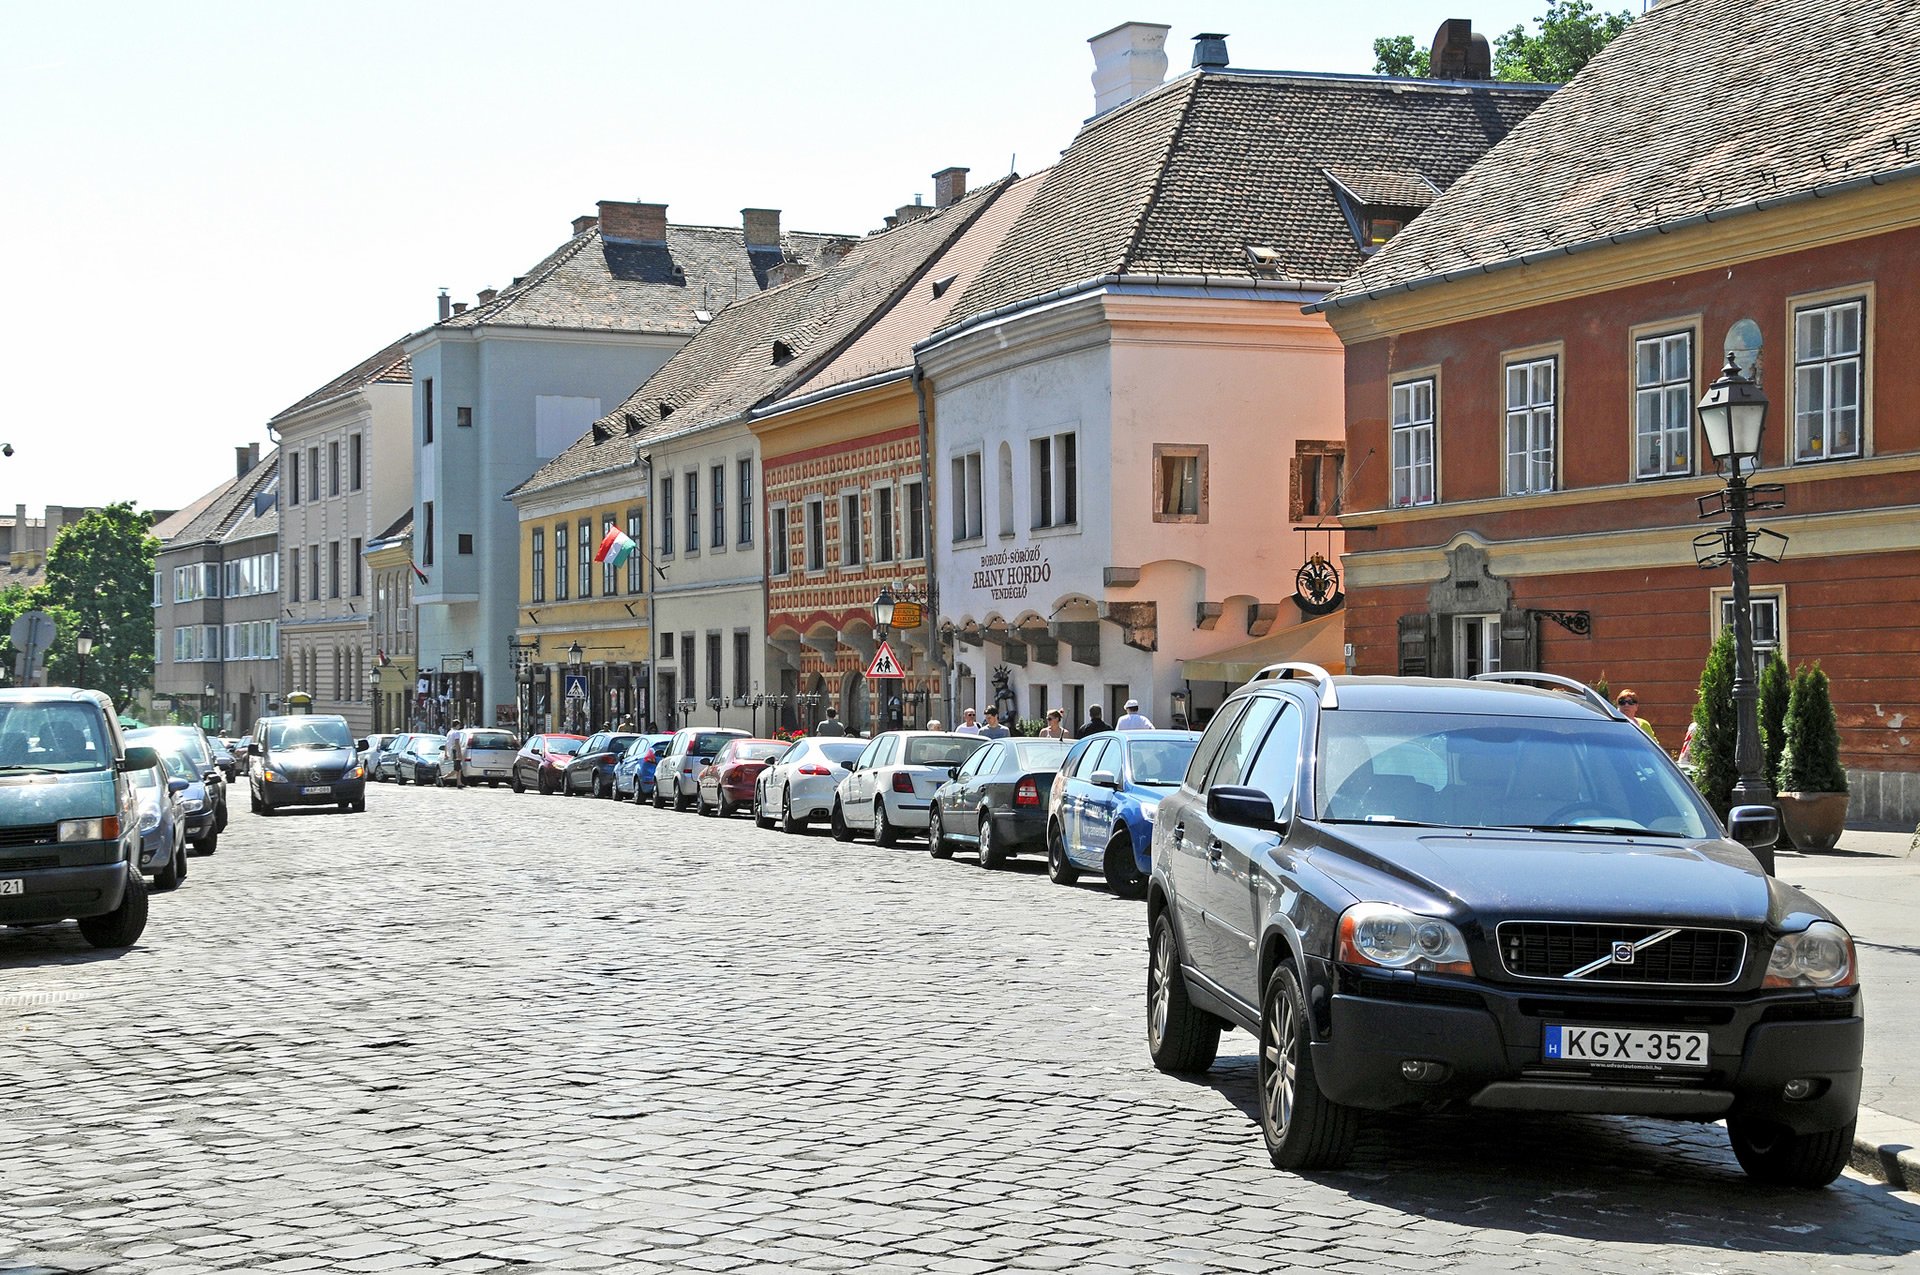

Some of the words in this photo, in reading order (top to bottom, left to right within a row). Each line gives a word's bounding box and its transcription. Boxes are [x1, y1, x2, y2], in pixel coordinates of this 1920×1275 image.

[972, 568, 1005, 589] ARANY
[1007, 558, 1052, 585] HORDÓ
[0, 880, 19, 894] 21
[1568, 1030, 1701, 1062] KGX-352
